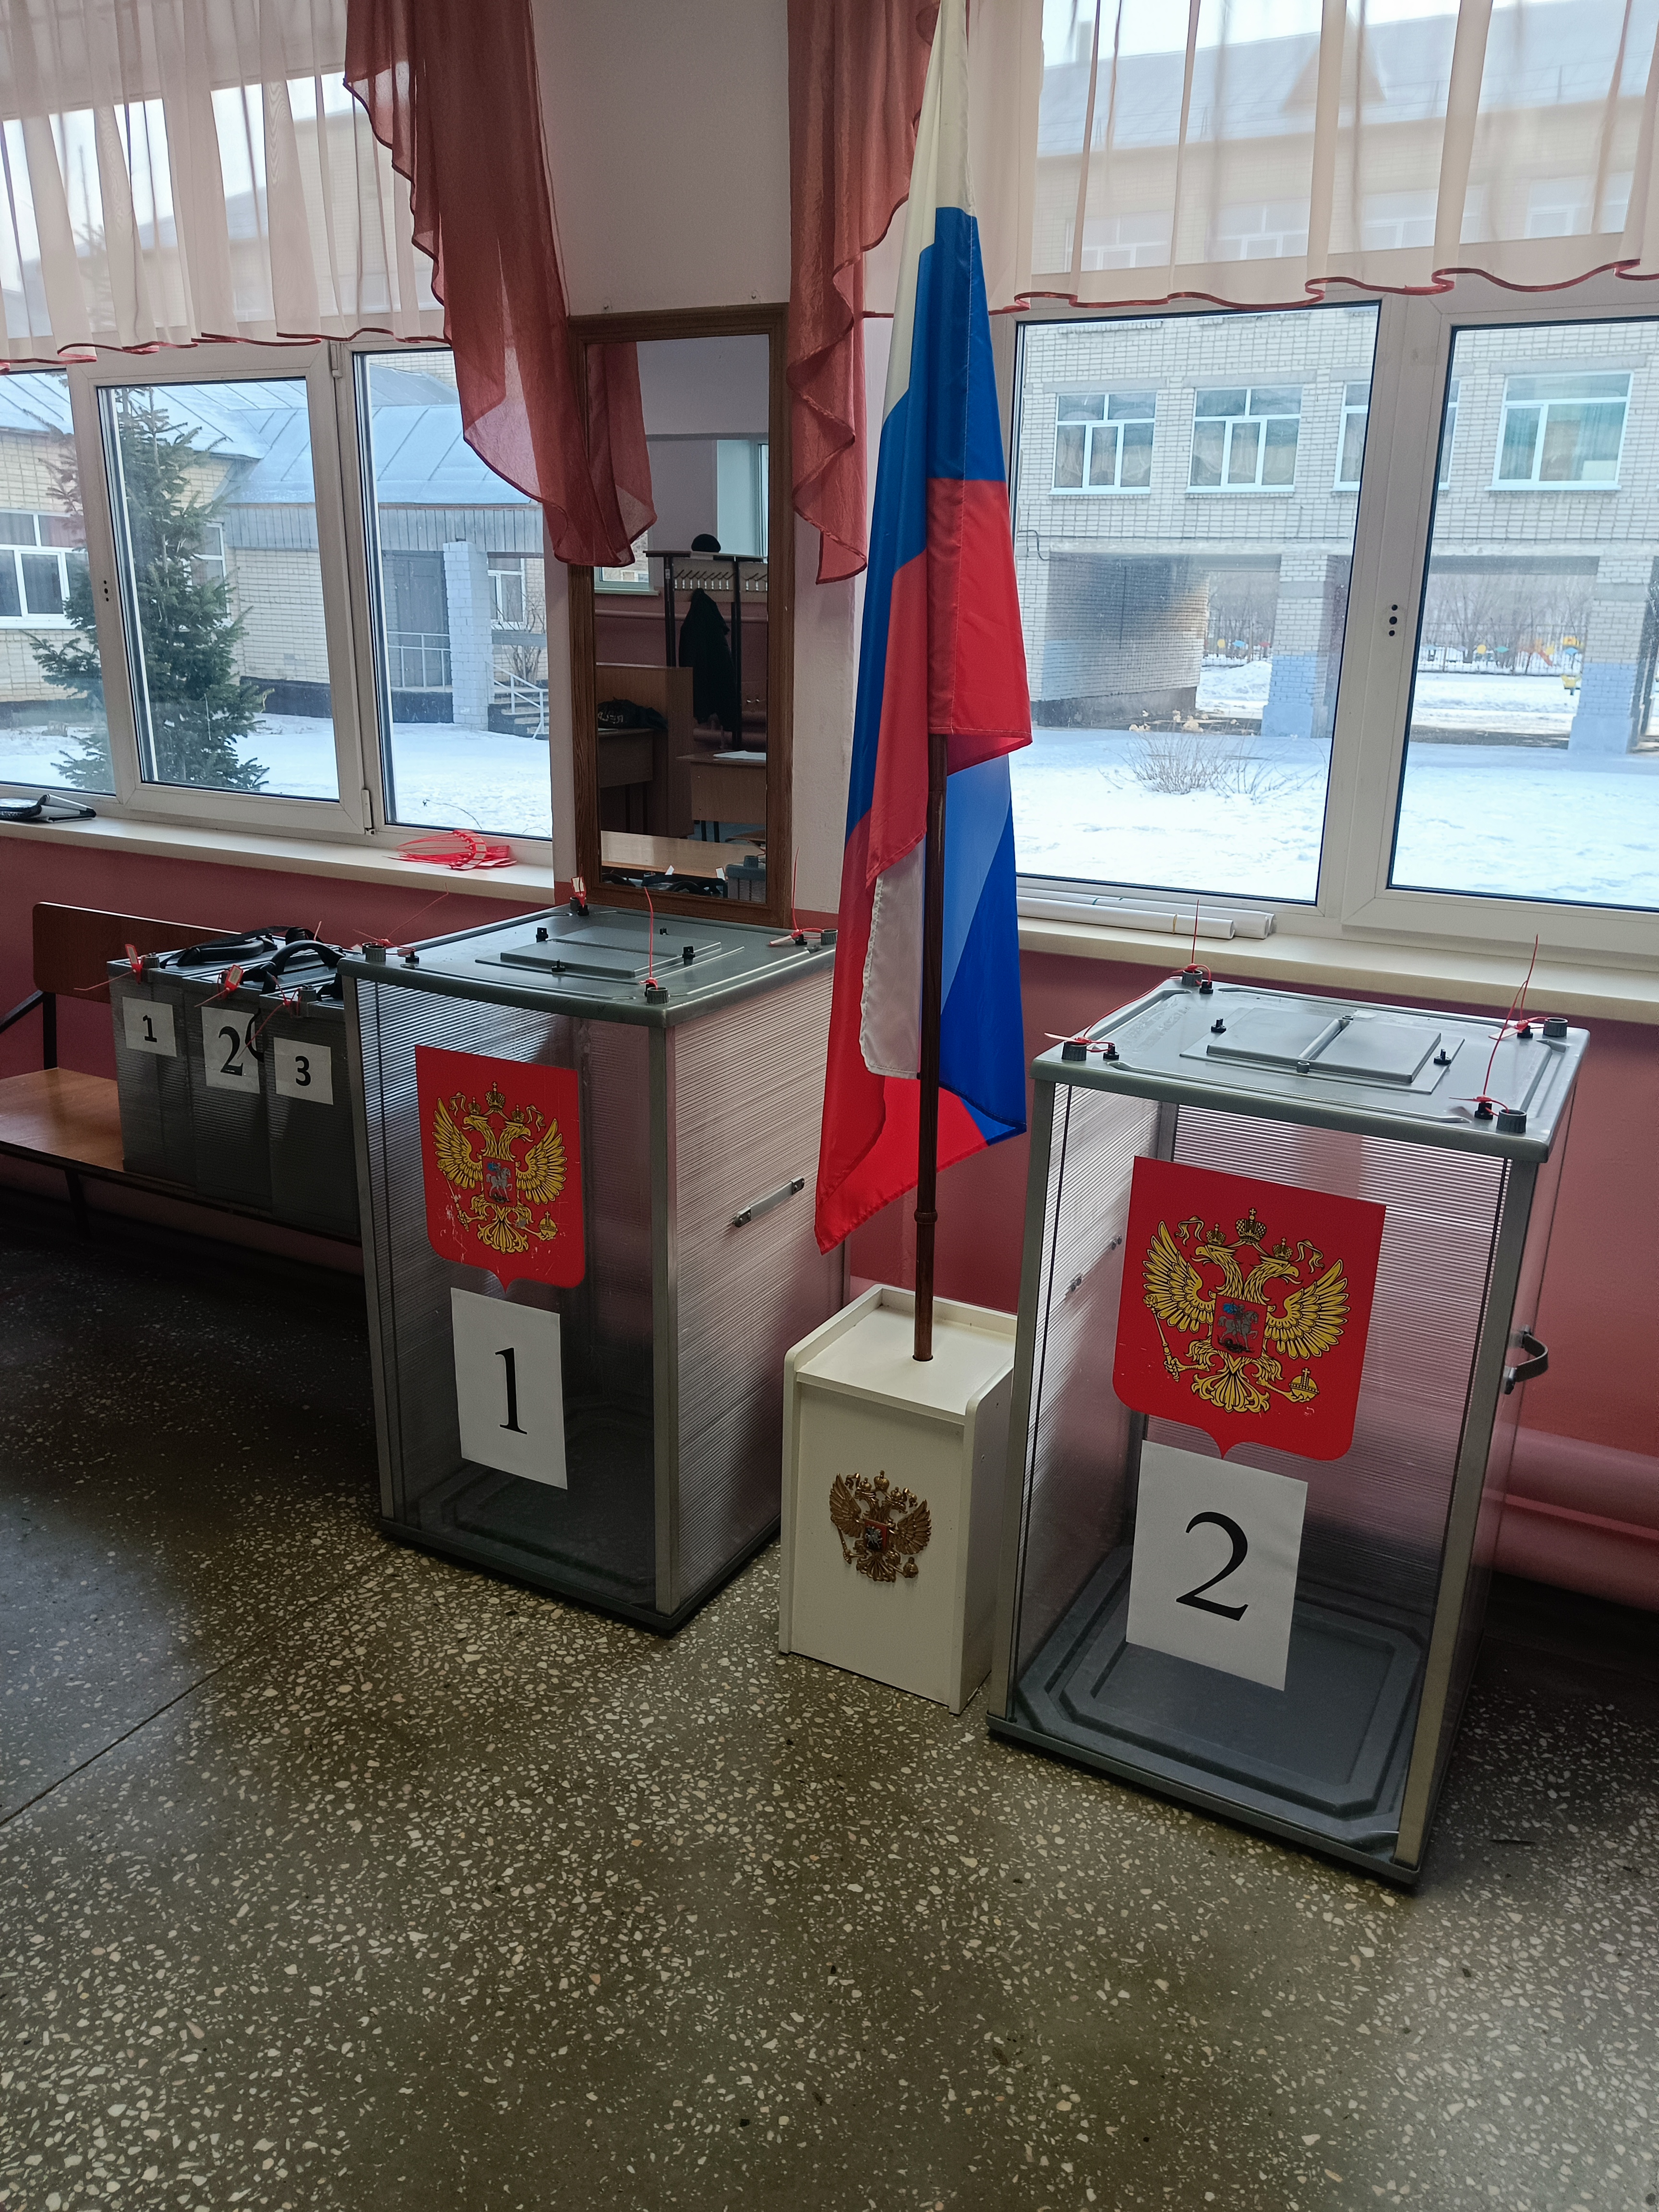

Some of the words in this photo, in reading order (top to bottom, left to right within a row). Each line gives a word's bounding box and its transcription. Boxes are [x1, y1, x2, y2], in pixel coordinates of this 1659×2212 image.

[143, 1014, 157, 1043] 1
[218, 1026, 243, 1076] 2
[295, 1056, 311, 1086] 3
[495, 1347, 528, 1435] 1
[1176, 1511, 1249, 1621] 2
